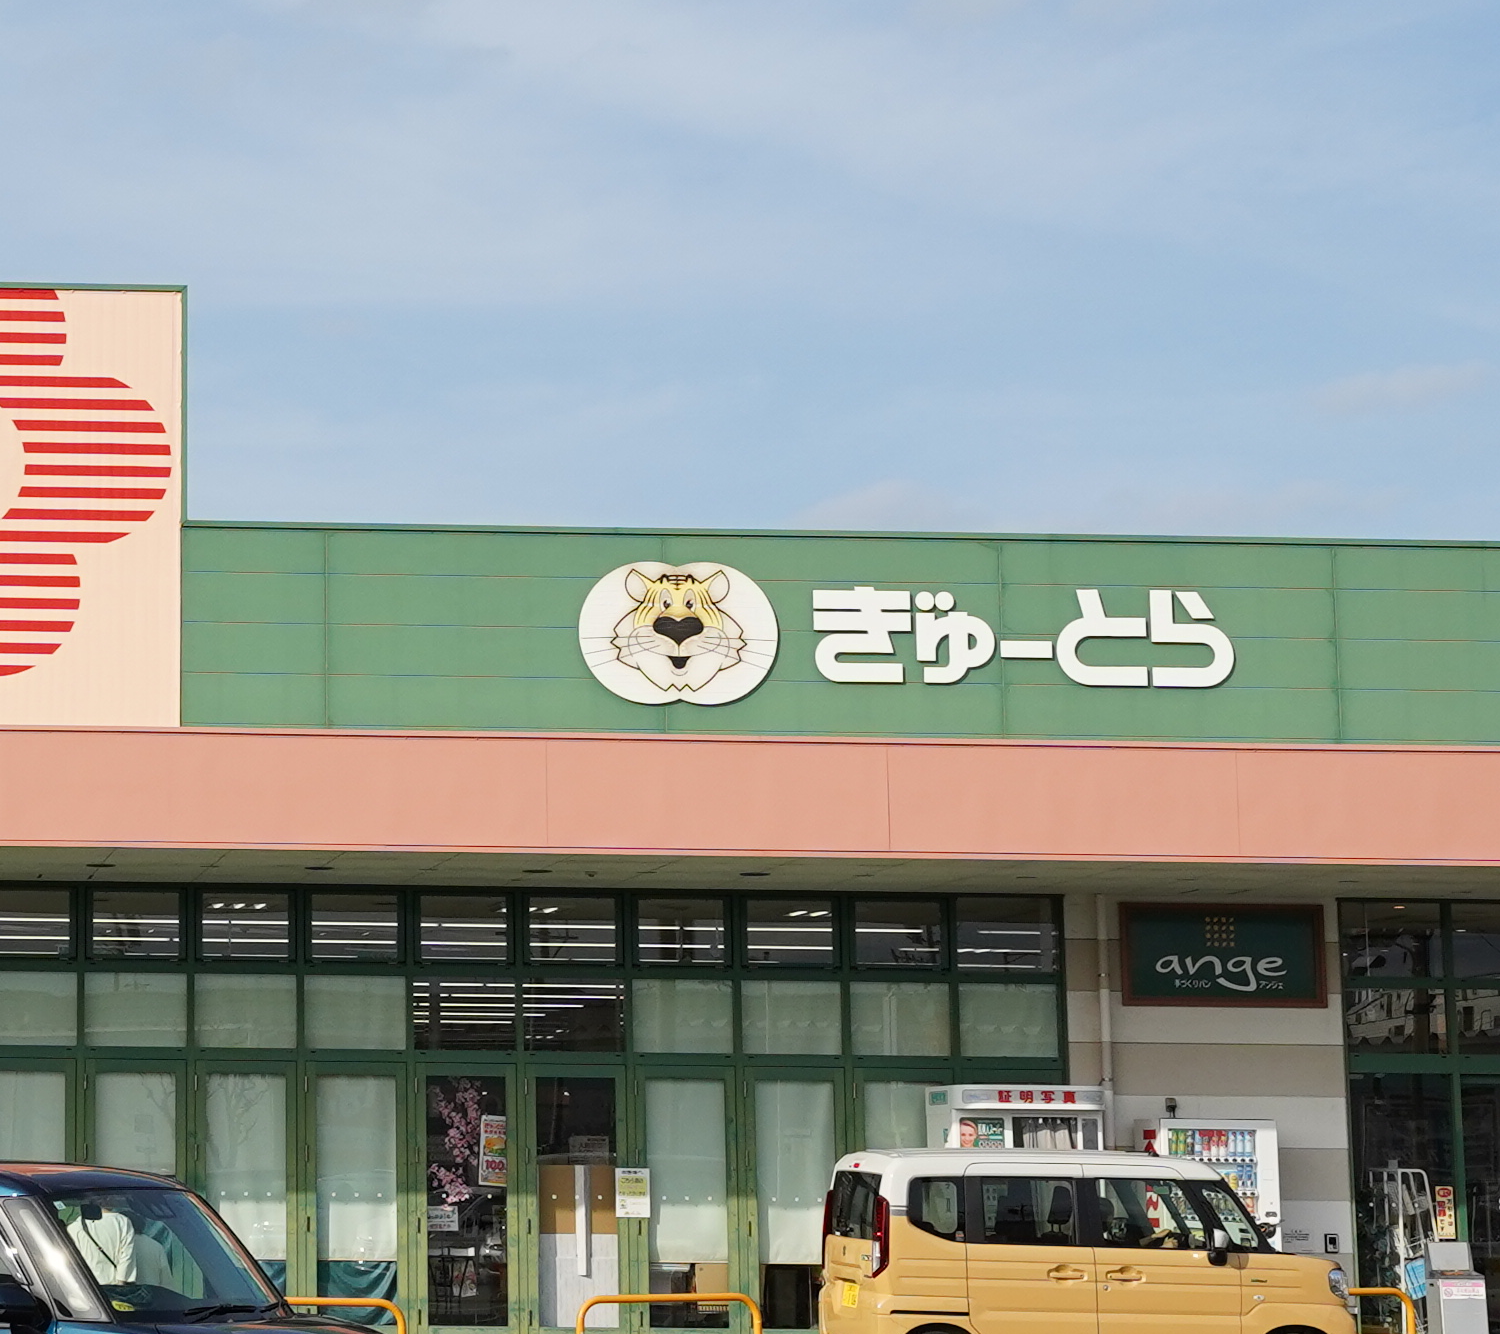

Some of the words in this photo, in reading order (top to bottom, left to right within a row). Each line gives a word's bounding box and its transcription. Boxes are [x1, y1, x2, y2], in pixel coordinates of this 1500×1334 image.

[811, 585, 1236, 688] ぎゅーとら
[1155, 953, 1288, 993] ange
[997, 1089, 1077, 1105] 証明写真
